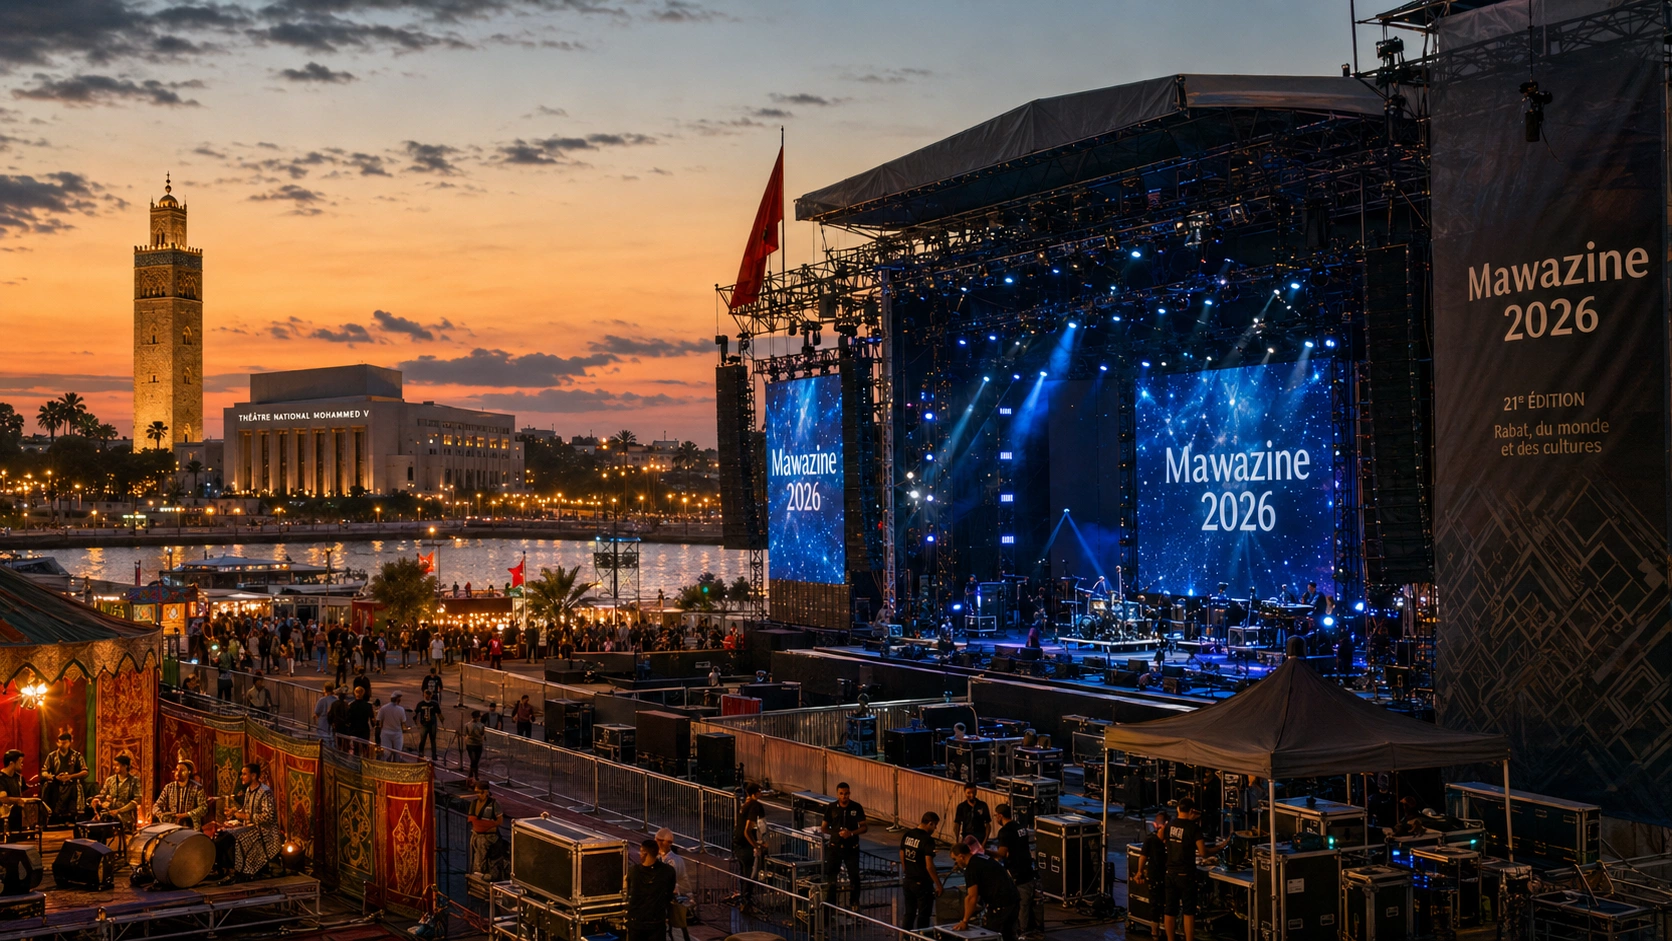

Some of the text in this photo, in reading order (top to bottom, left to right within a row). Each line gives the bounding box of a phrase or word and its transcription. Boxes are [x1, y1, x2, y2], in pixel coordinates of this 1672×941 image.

[1468, 240, 1649, 302] Mawazine
[1503, 295, 1599, 342] 2026
[238, 410, 370, 421] THÉÂTRE NATIONAL MOHAMMED V
[1528, 390, 1585, 409] ÉDITION
[1494, 417, 1610, 440] Rabat, du monde
[771, 444, 837, 477] Mawazine
[1165, 439, 1310, 484] Mawazine
[1501, 438, 1603, 456] et des cultures
[786, 481, 821, 512] 2026
[1201, 490, 1277, 532] 2026
